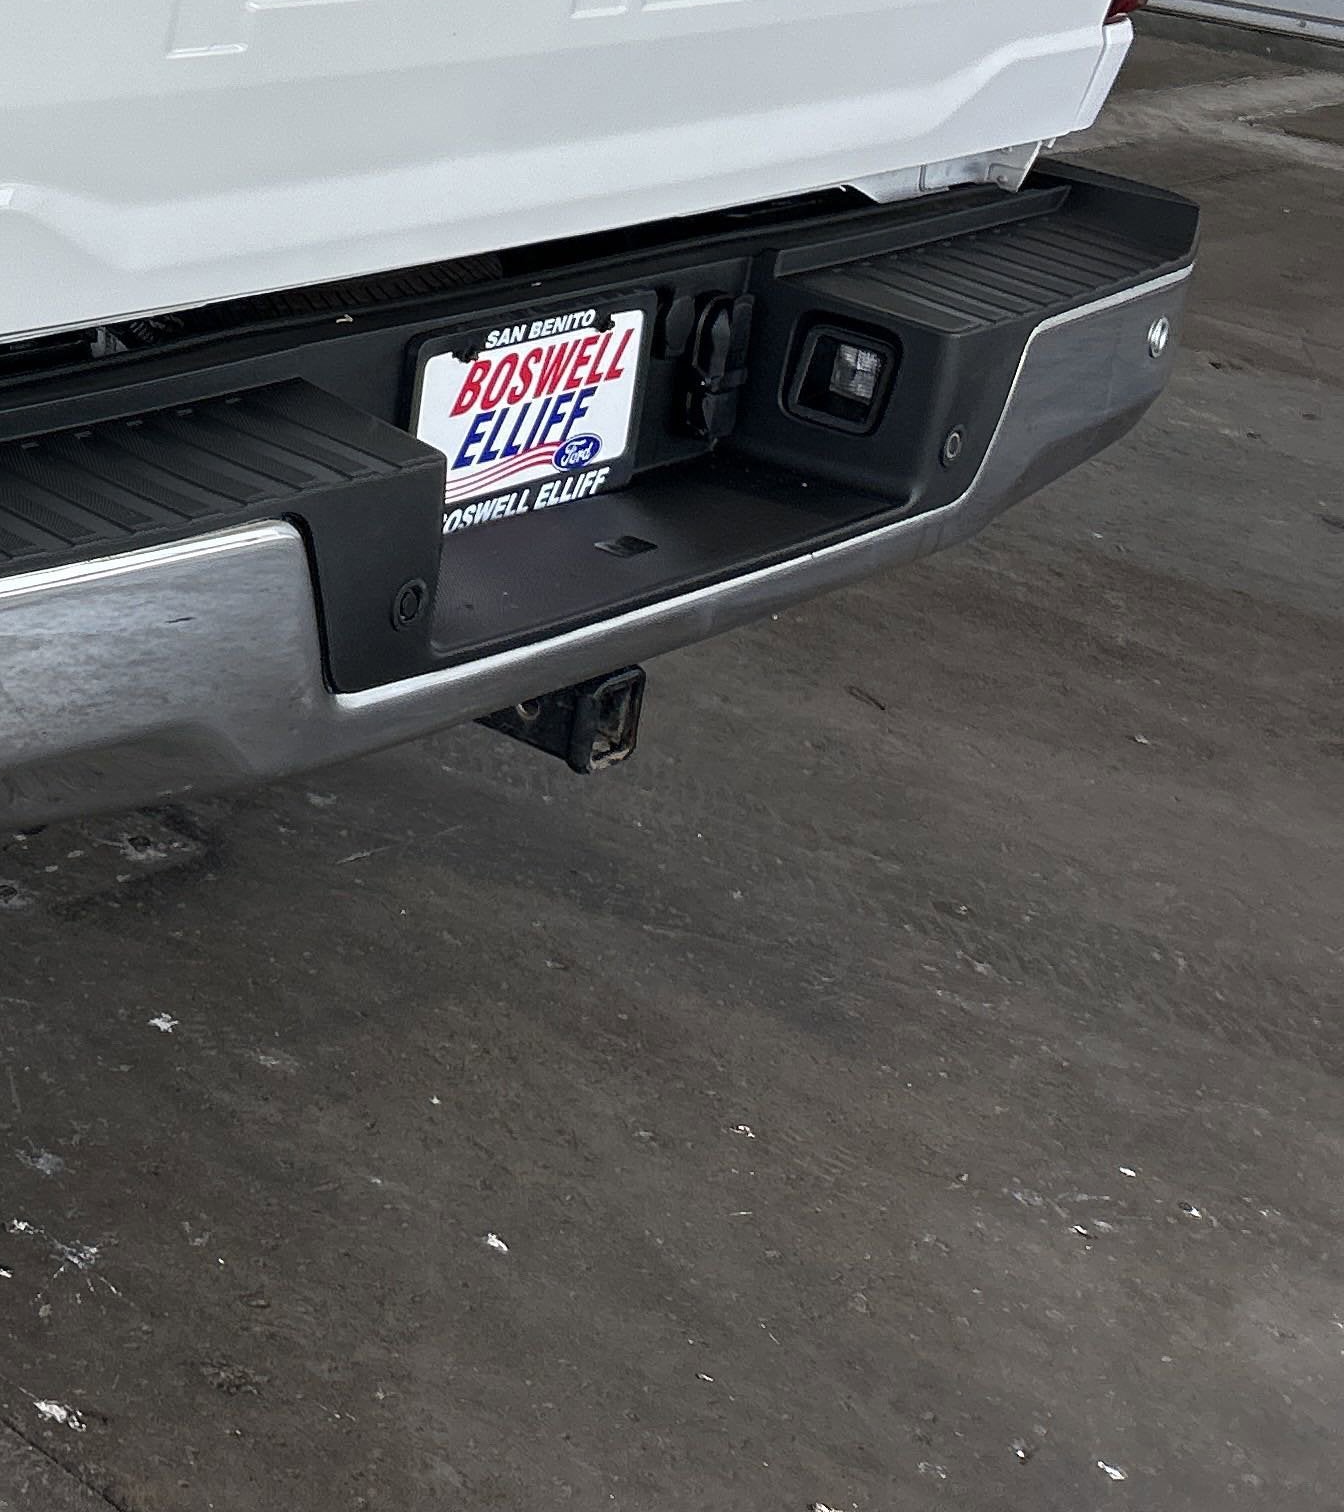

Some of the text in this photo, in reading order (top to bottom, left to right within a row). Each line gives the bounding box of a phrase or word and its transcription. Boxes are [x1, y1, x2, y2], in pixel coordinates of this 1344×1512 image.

[485, 309, 596, 349] SAN BENITO
[449, 328, 636, 418] BOSWELL
[451, 385, 599, 470] ELLIFF
[560, 438, 594, 467] Ford
[442, 466, 610, 535] OSWELL ELLIFF
